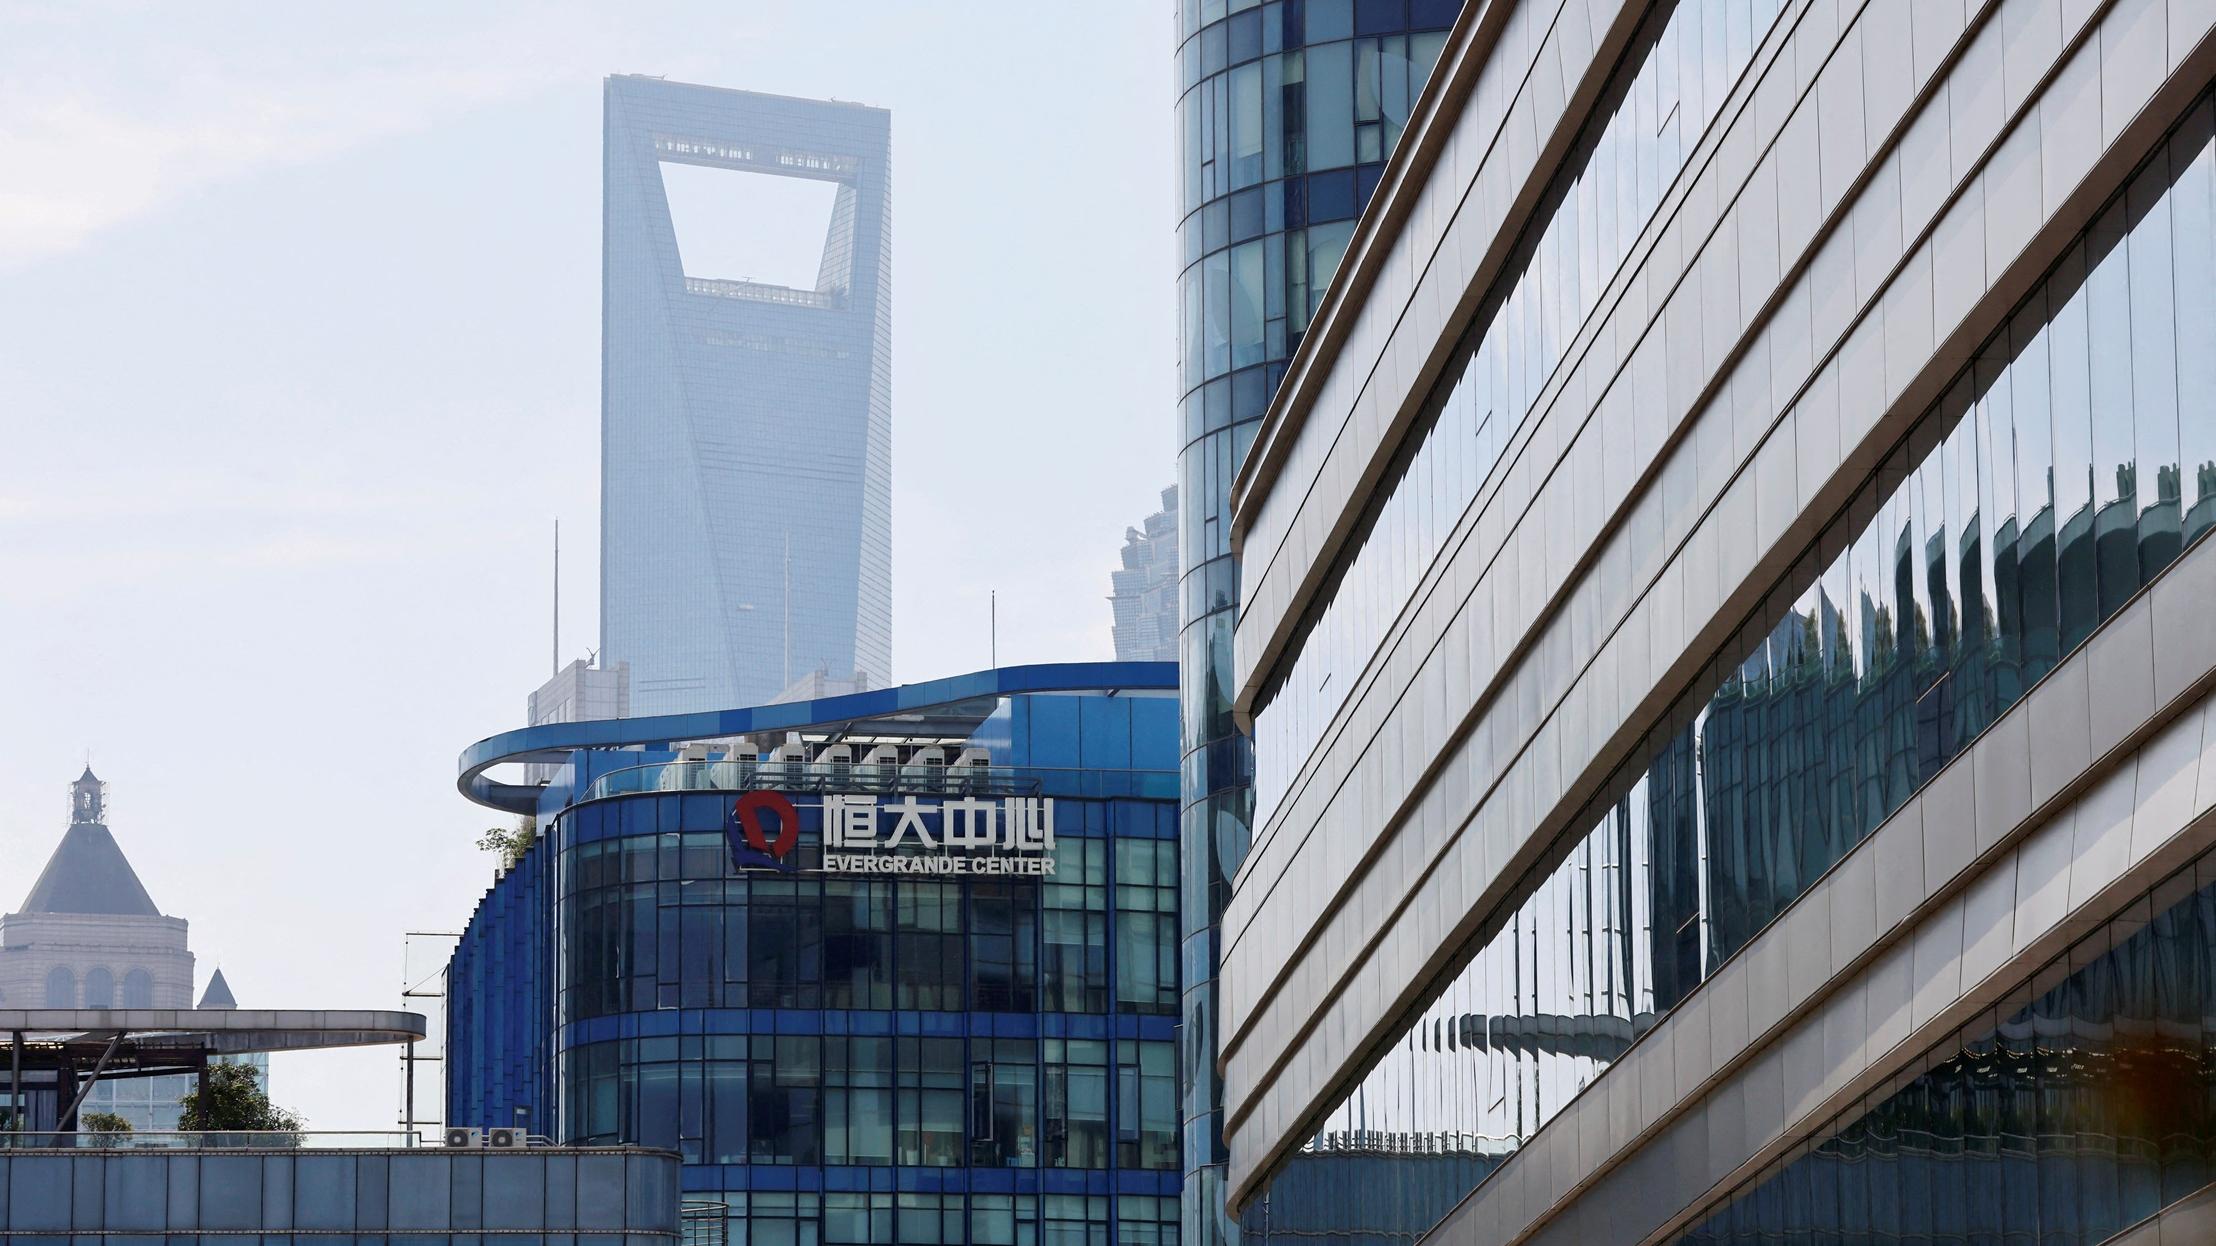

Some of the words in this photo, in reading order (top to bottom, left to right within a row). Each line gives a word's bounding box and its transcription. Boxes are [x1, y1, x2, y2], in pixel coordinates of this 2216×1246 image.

[823, 795, 1055, 849] 恒大中心
[823, 855, 966, 874] EVERGRANDE
[972, 857, 1056, 875] CENTER
